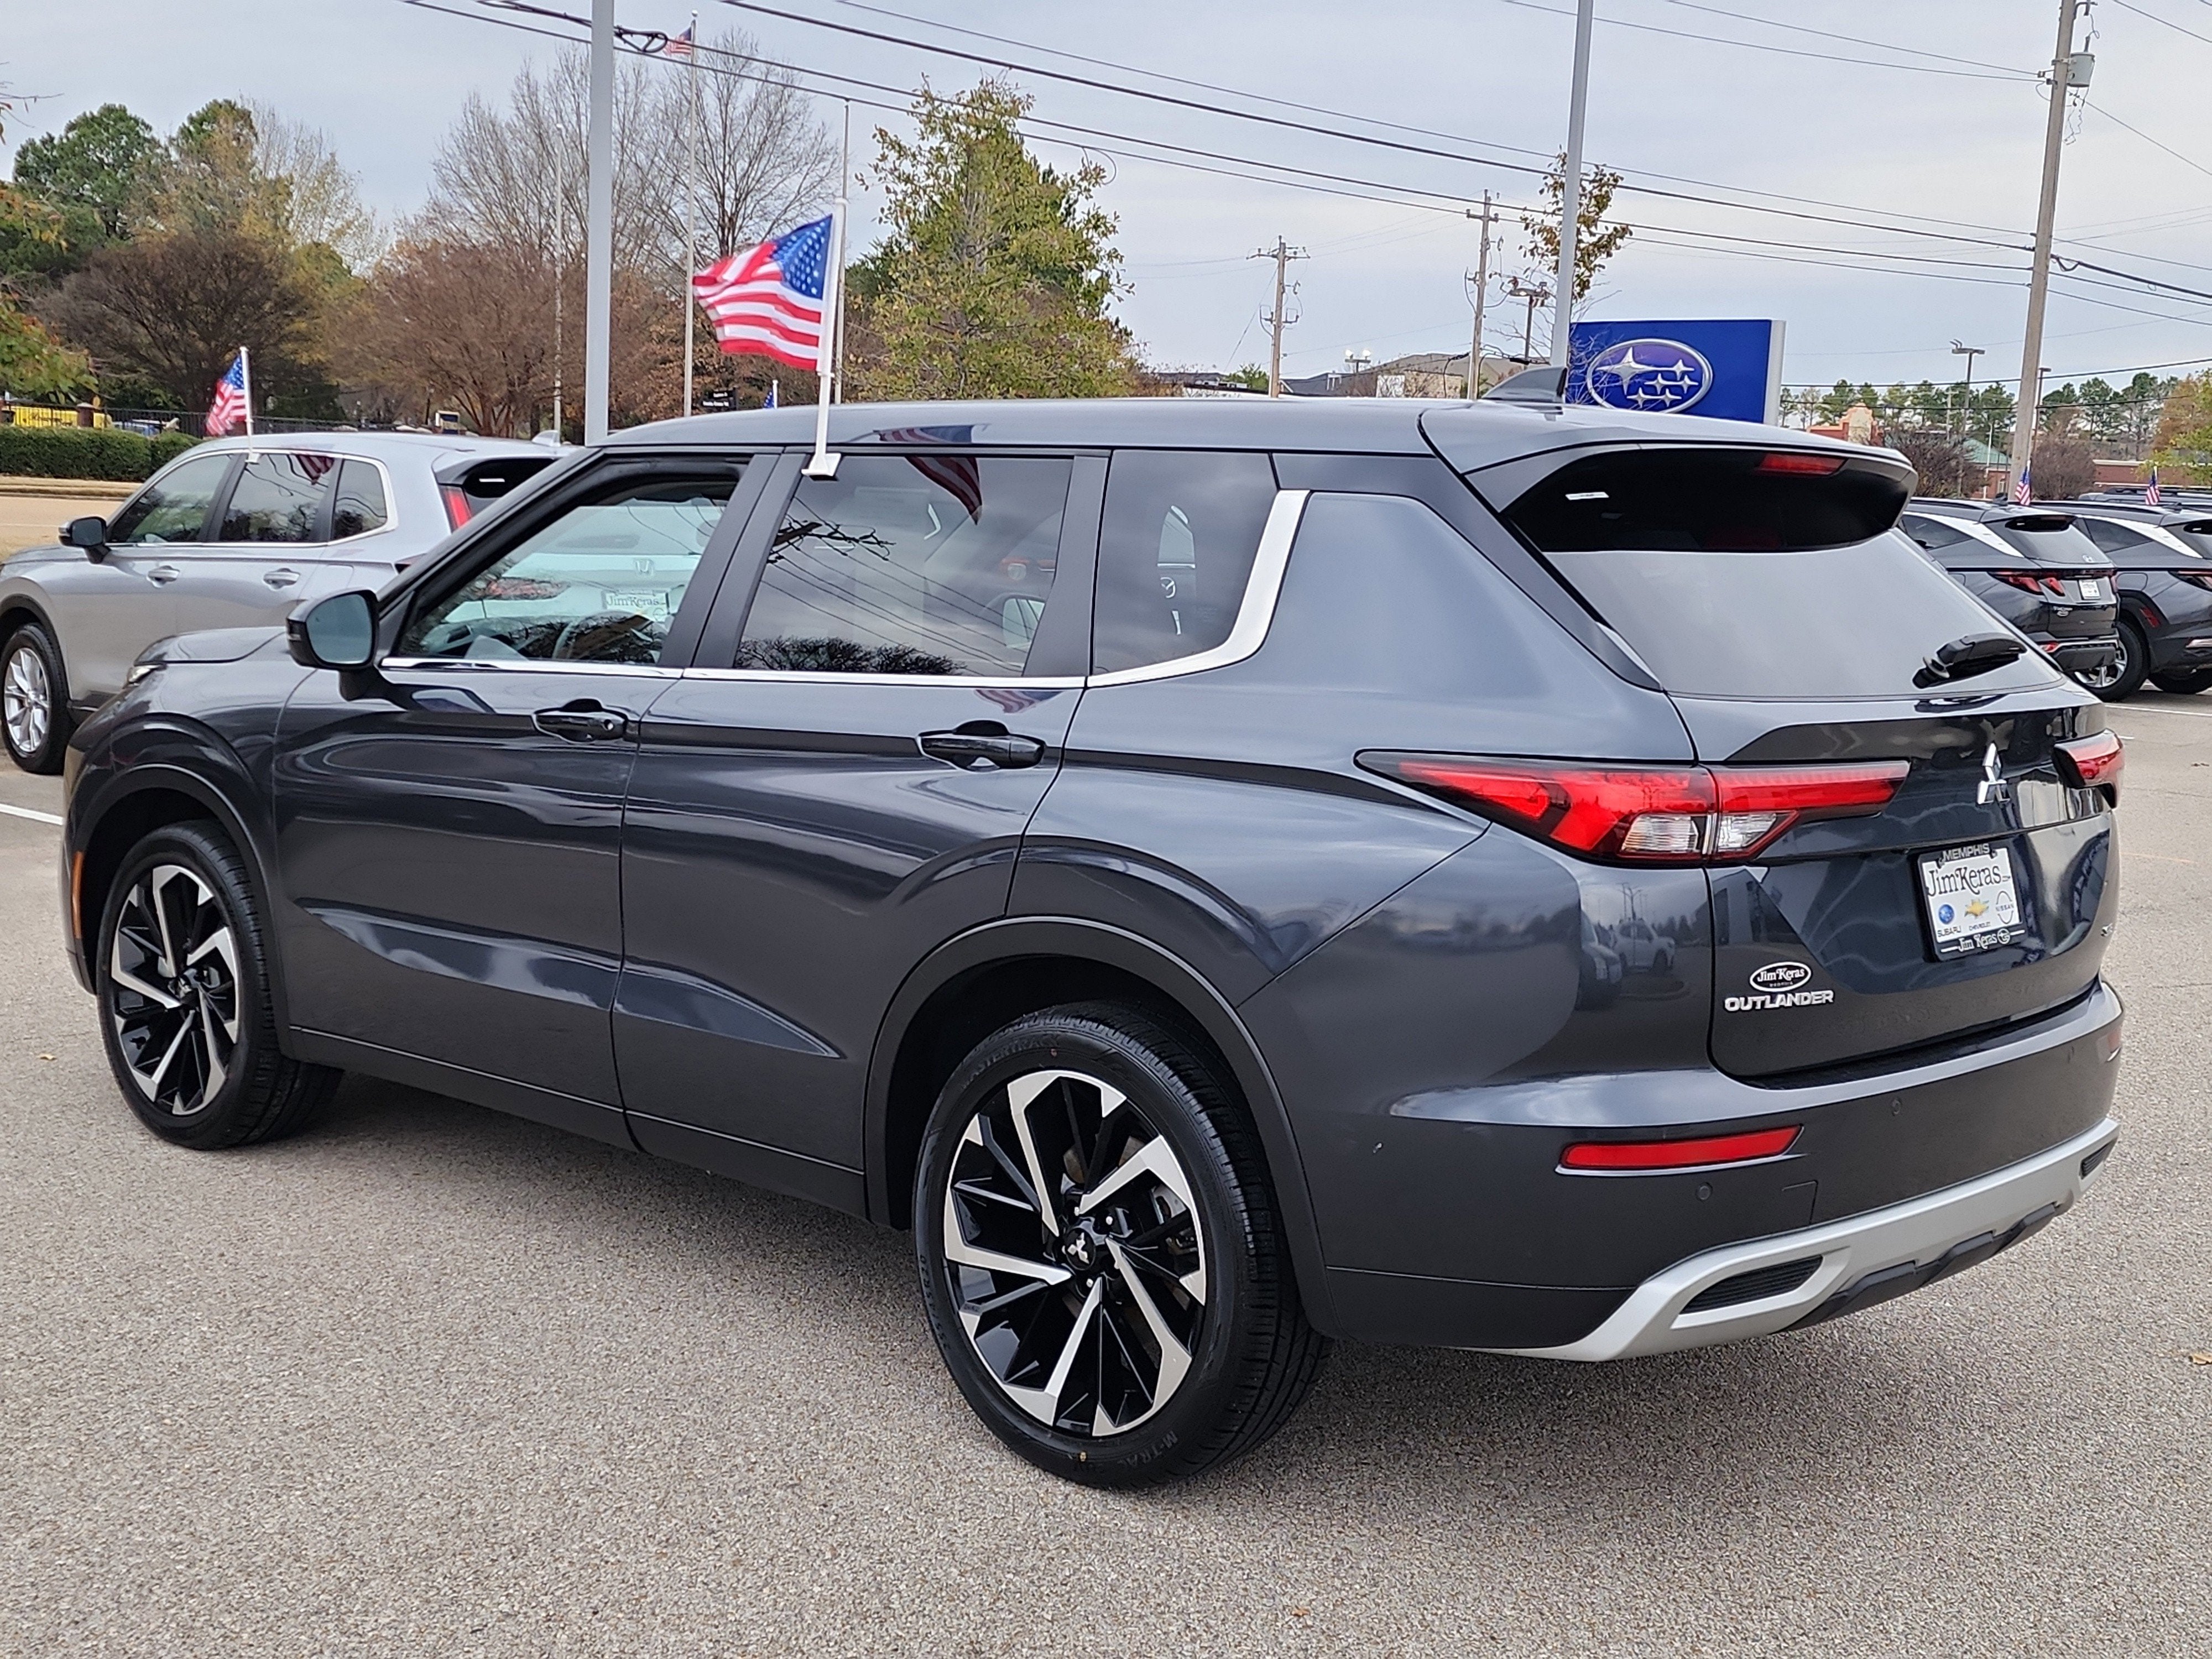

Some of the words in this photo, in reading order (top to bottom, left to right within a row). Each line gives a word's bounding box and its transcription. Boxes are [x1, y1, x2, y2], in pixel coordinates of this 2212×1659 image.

[1942, 843, 1990, 861] MEMPHIS
[1995, 903, 2015, 912] NISSAN
[1937, 926, 1961, 937] SUBARU
[1724, 990, 1834, 1012] OUTLANDER
